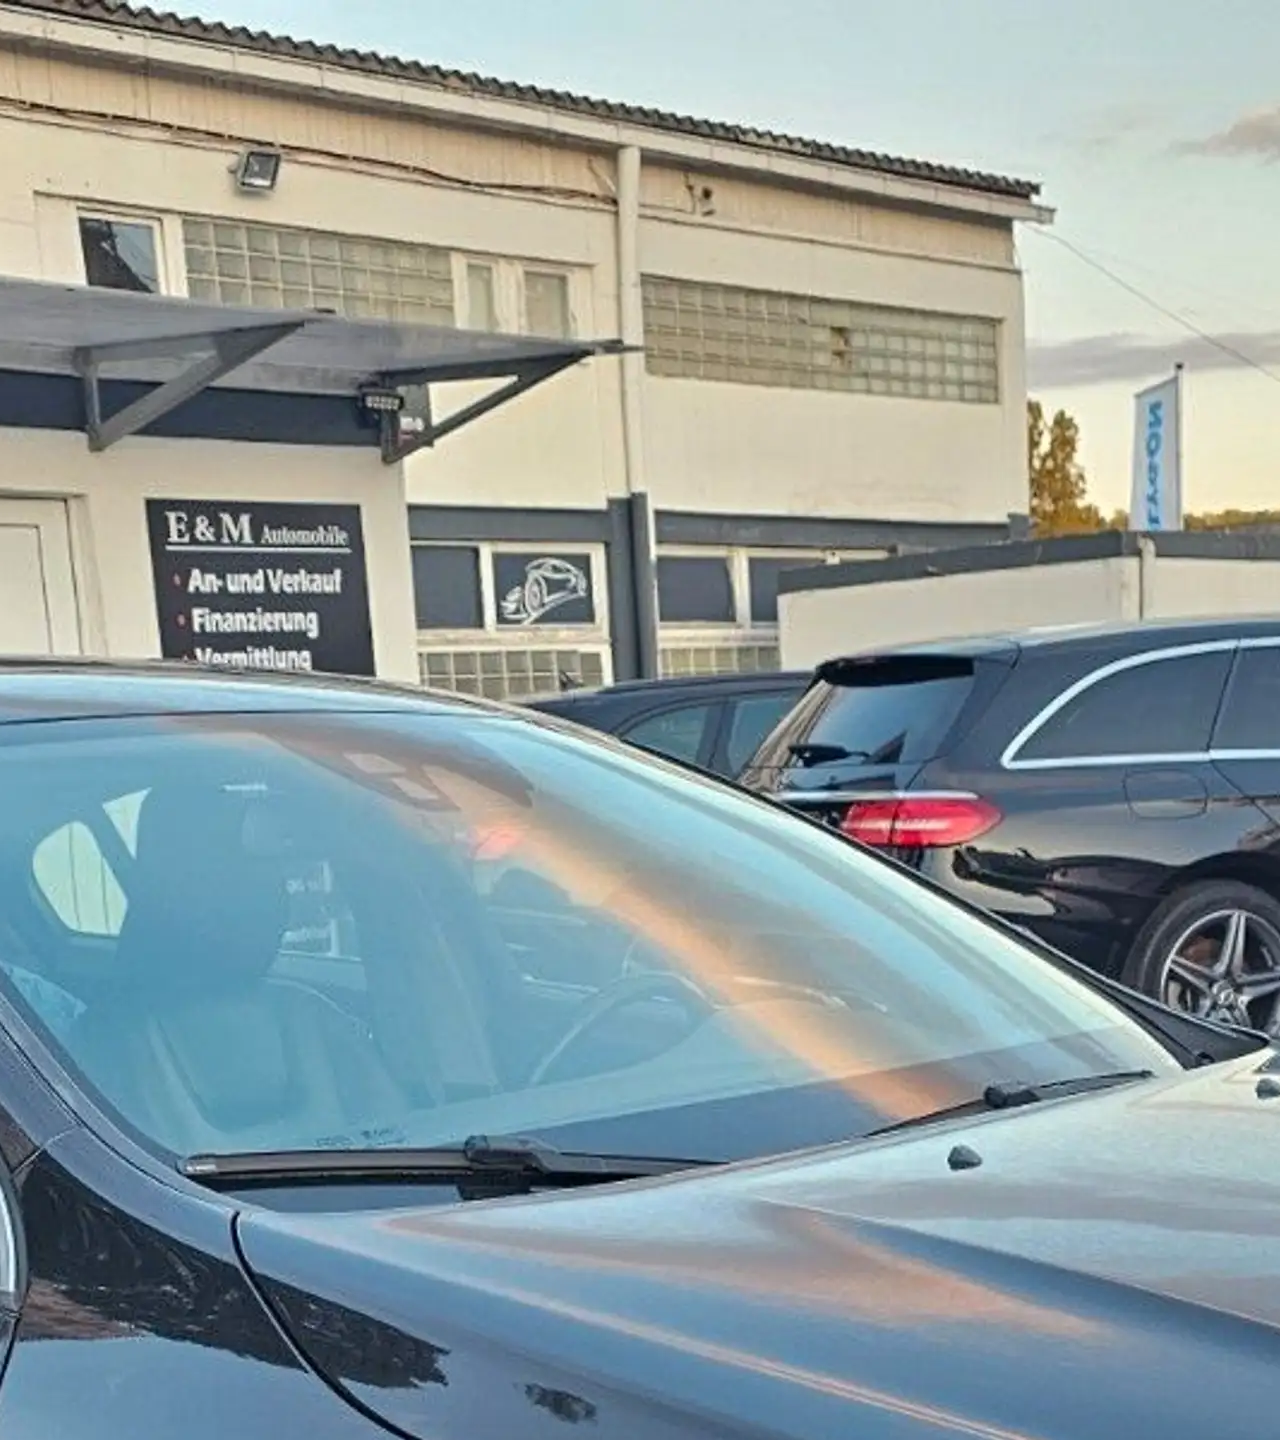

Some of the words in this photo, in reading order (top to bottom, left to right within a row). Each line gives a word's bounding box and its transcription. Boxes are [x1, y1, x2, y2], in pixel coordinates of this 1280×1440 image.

[260, 524, 349, 546] Automobile
[187, 567, 224, 593] An-
[226, 568, 265, 593] und
[266, 567, 342, 593] Verkauf
[191, 606, 320, 639] Finanzierung
